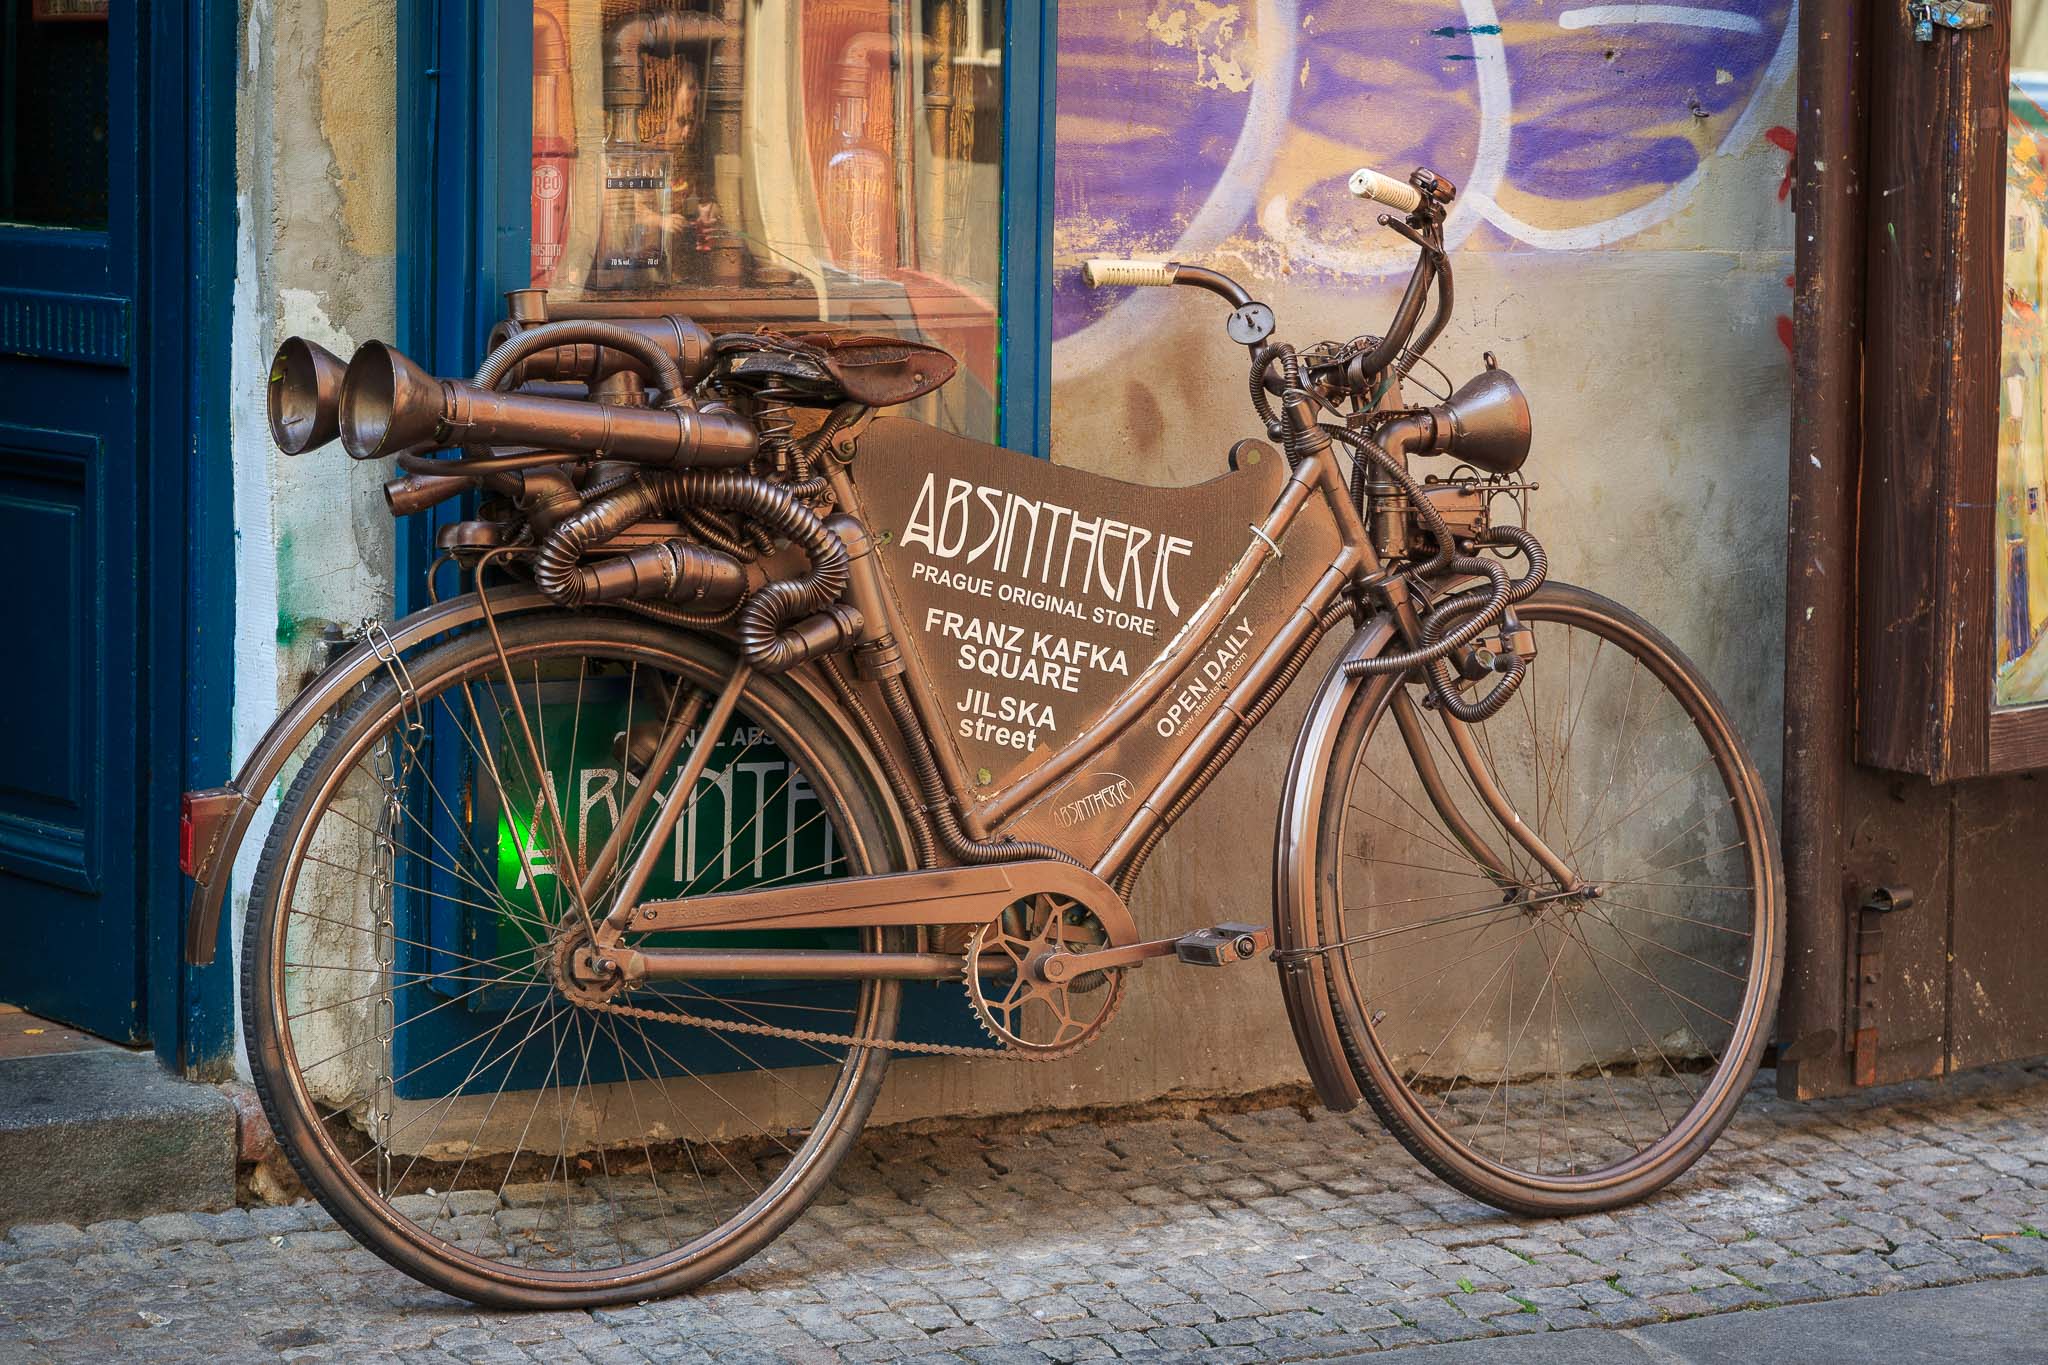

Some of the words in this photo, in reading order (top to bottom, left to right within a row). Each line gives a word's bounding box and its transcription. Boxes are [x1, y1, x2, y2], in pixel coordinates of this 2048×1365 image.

[607, 179, 664, 188] Beetle
[899, 472, 1193, 618] ABSINTHERIE
[911, 562, 993, 598] PRAGUE
[1000, 584, 1087, 621] ORIGINAL
[1093, 606, 1155, 637] STORE
[924, 608, 1025, 652] FRANZ
[1032, 631, 1129, 676] KAFKA
[957, 646, 1081, 693] SQUARE
[1157, 677, 1209, 738] OPEN
[1203, 617, 1254, 682] DAILY
[1175, 652, 1248, 737] www.absintshop.com
[956, 688, 1057, 732] JILSKA
[958, 715, 1037, 752] street
[1052, 779, 1132, 829] ABSINTHERIE
